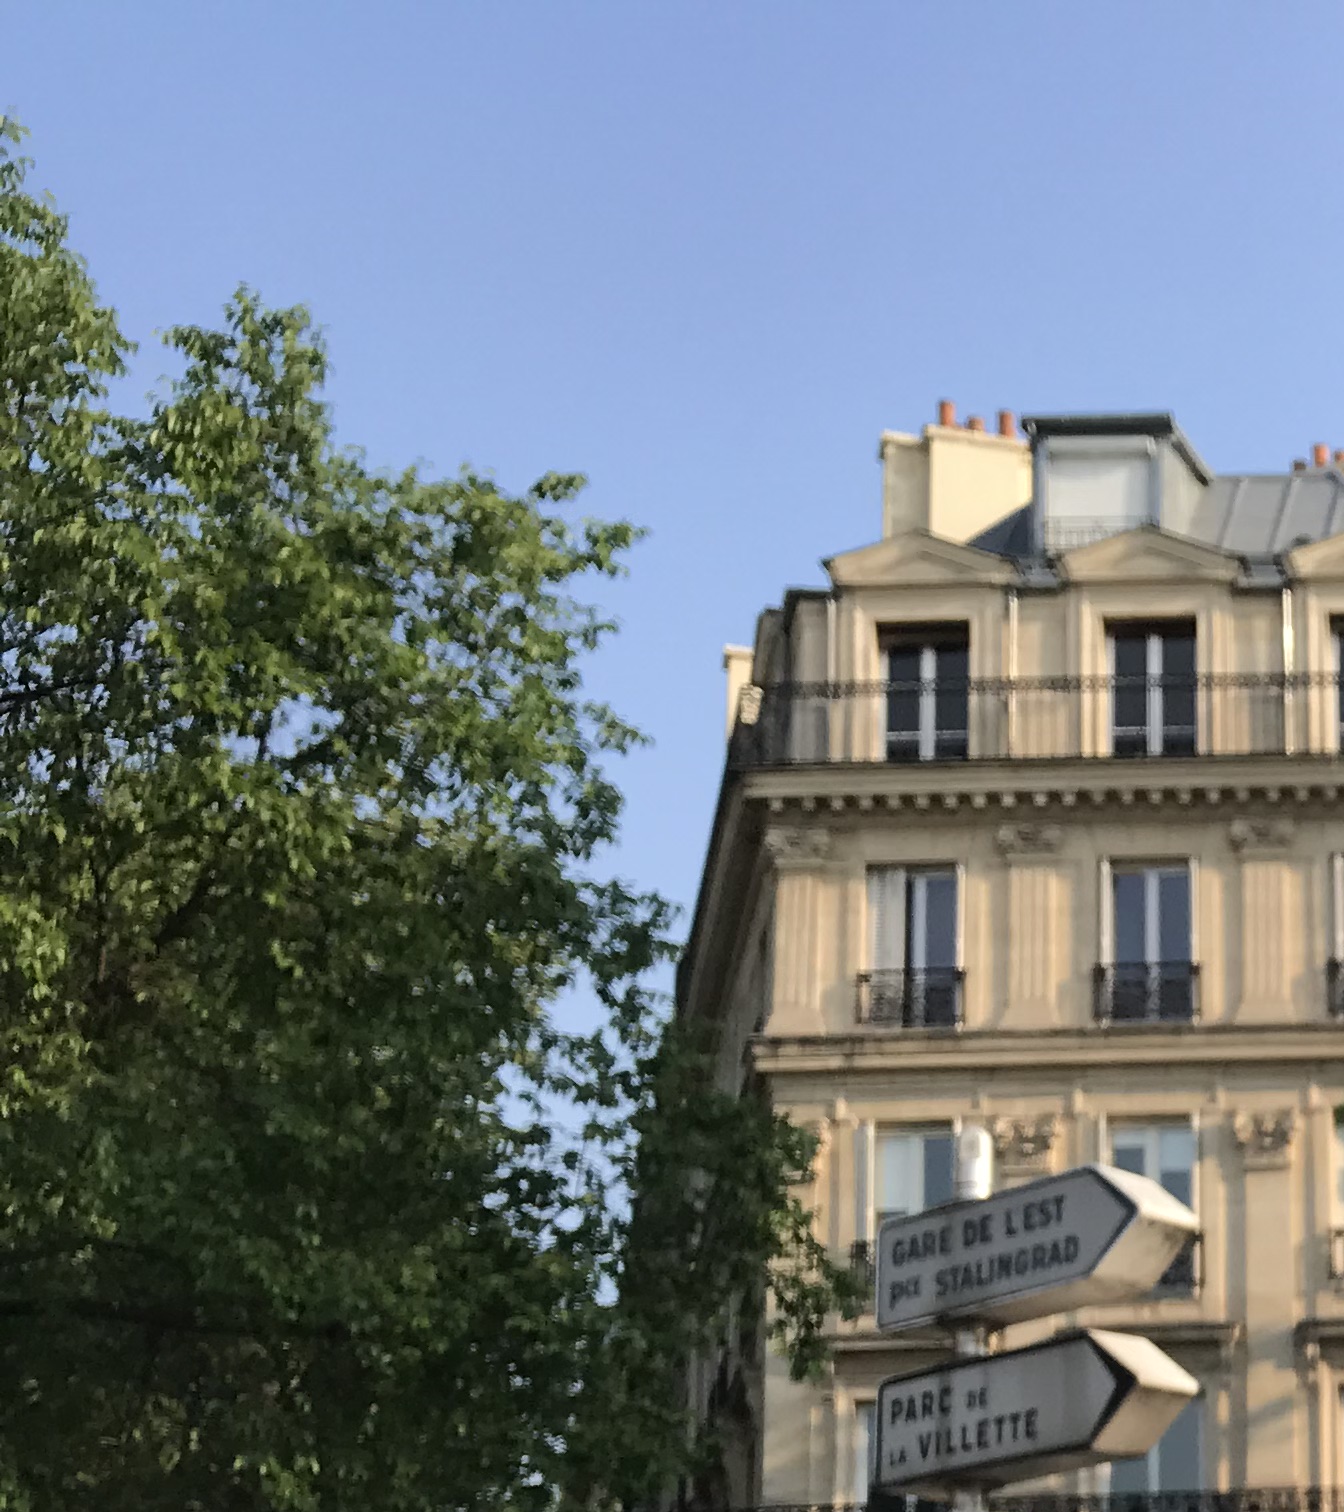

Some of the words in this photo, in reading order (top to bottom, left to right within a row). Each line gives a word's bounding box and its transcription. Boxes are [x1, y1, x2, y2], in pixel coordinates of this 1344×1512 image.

[893, 1226, 951, 1267] GARE
[963, 1213, 993, 1247] DE
[936, 1235, 1079, 1296] STALINGRAD
[891, 1386, 952, 1425] PARC
[918, 1406, 1039, 1460] VILLETTE
